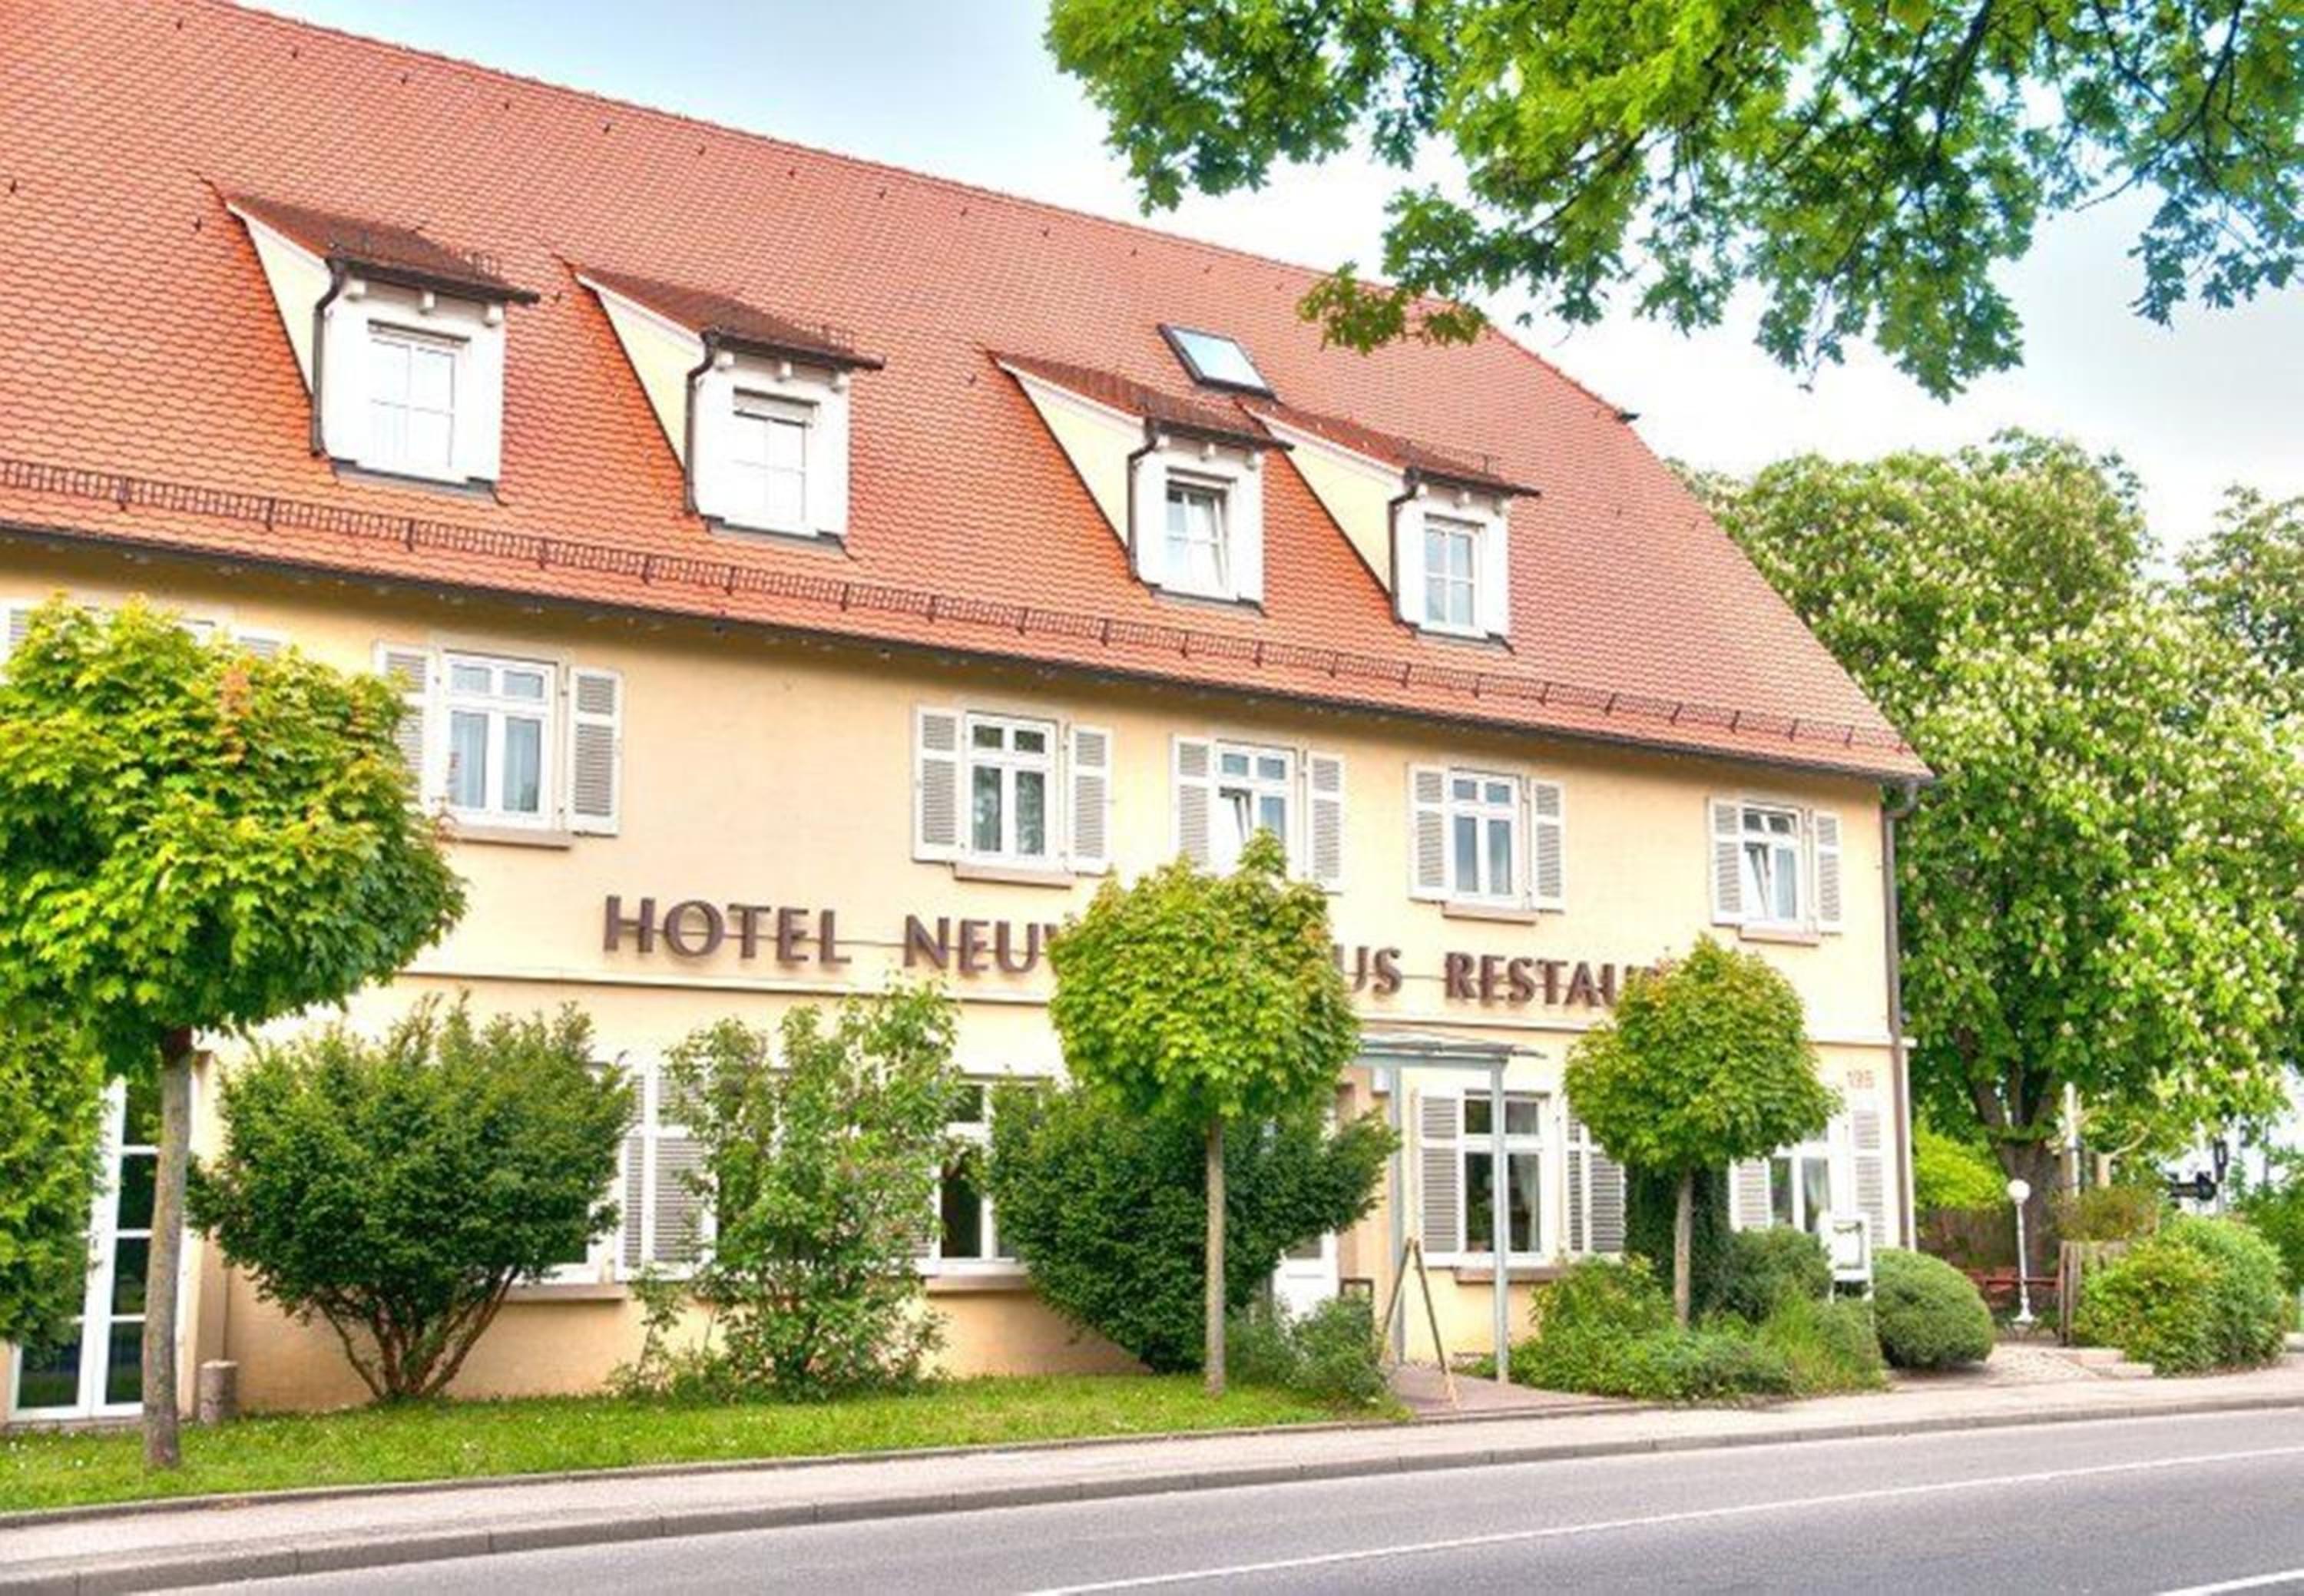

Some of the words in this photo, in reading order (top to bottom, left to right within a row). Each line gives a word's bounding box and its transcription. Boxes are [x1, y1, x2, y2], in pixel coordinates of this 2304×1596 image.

[604, 895, 851, 965] HOTEL
[903, 914, 1058, 974] NEU
[1445, 952, 1656, 1008] RESTAU
